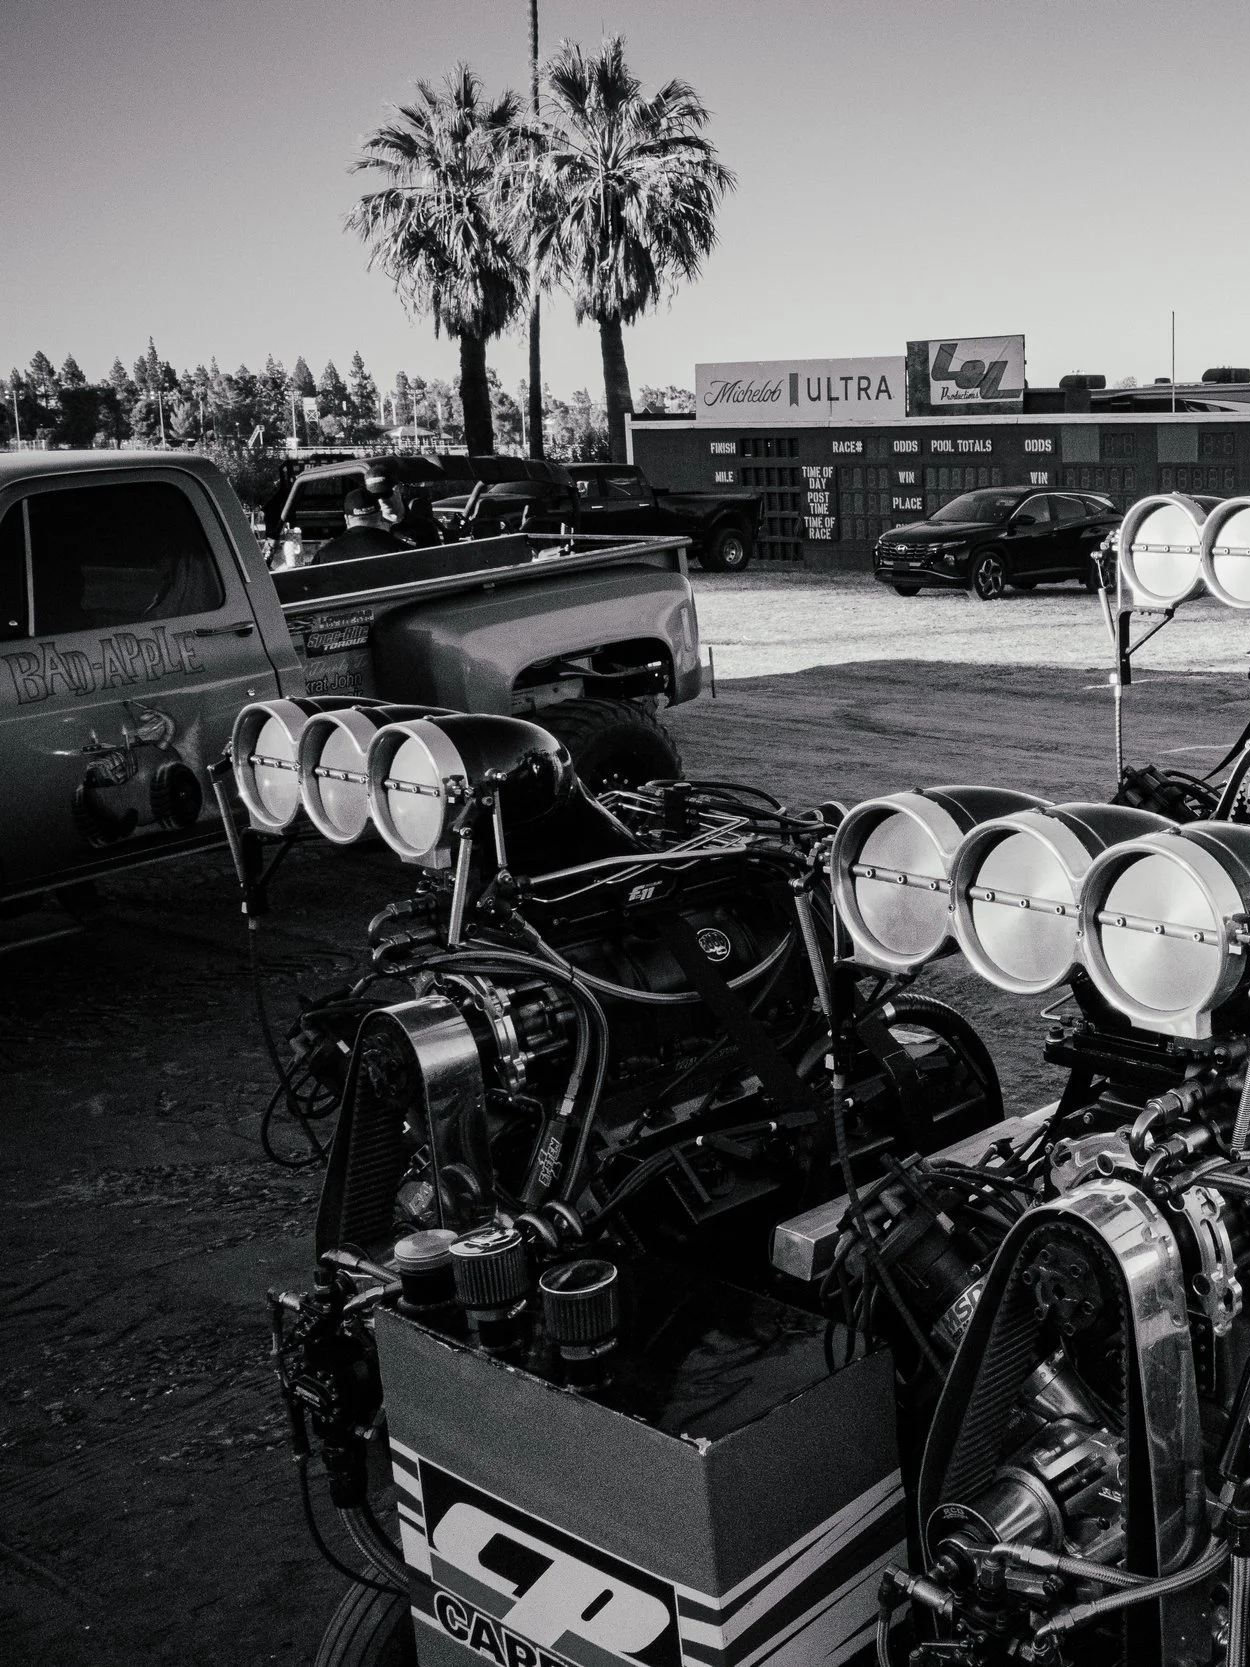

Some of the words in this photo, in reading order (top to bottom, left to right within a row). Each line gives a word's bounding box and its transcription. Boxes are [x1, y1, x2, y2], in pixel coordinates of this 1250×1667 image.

[704, 379, 785, 407] Michelob
[807, 375, 892, 402] ULTRA
[941, 386, 980, 401] Productions
[710, 442, 736, 454] FINISH
[832, 440, 863, 453] RACE#
[893, 439, 919, 453] ODDS
[931, 440, 955, 452] POOL
[957, 439, 992, 452] TOTALS
[1024, 439, 1052, 452] ODDS
[801, 466, 821, 478] TIME
[822, 466, 834, 478] OF
[898, 471, 915, 484] WIN
[1030, 472, 1048, 484] WIN
[808, 477, 827, 489] DAY
[807, 491, 830, 503] POST
[892, 497, 923, 509] PLACE
[809, 503, 829, 515] TIME
[803, 516, 823, 528] TIME
[824, 517, 836, 528] OF
[809, 528, 832, 540] RACE
[1, 626, 204, 705] BAD-APPLE
[331, 672, 363, 690] John
